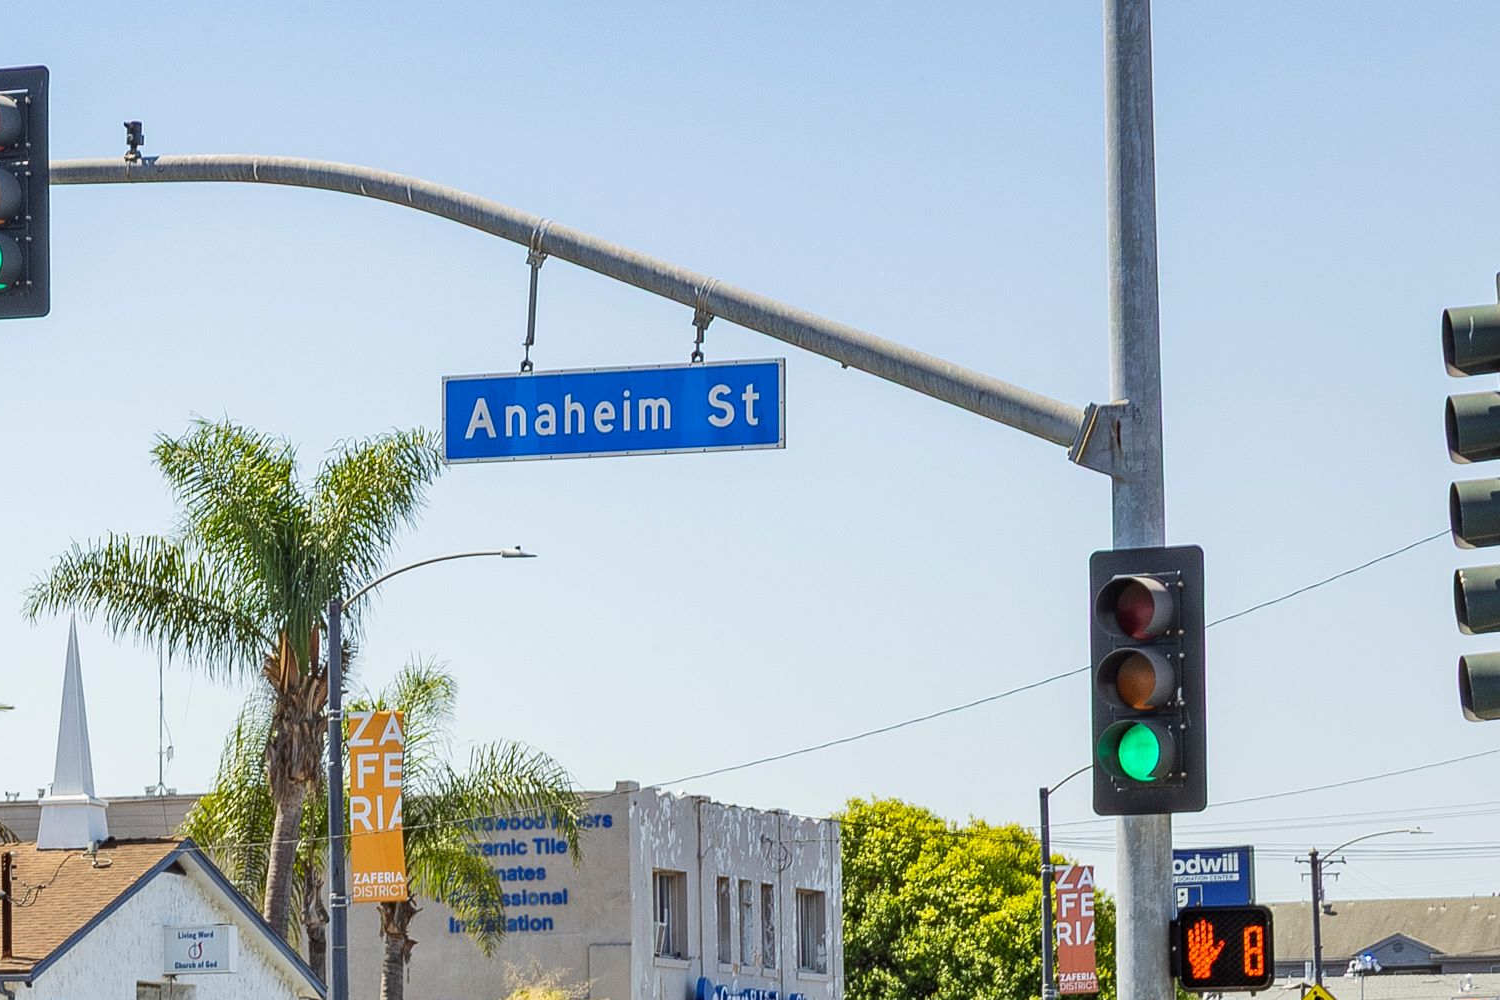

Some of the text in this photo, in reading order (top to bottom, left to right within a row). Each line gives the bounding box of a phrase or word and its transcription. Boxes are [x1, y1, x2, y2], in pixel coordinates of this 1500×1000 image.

[464, 383, 760, 440] Anaheim St
[347, 711, 404, 747] ZA
[356, 752, 403, 789] FE
[463, 837, 568, 857] ramic Tile
[1172, 852, 1239, 875] odwill
[353, 871, 405, 884] ZAFERIA
[1054, 865, 1094, 890] ZA
[353, 884, 405, 898] DISTRICT
[1061, 892, 1095, 918] FE
[177, 932, 197, 940] Living
[1243, 925, 1264, 977] 8
[174, 961, 197, 969] Church
[205, 960, 218, 968] God
[1060, 972, 1097, 982] ZAFERIA
[1060, 981, 1097, 991] DISTRICT
